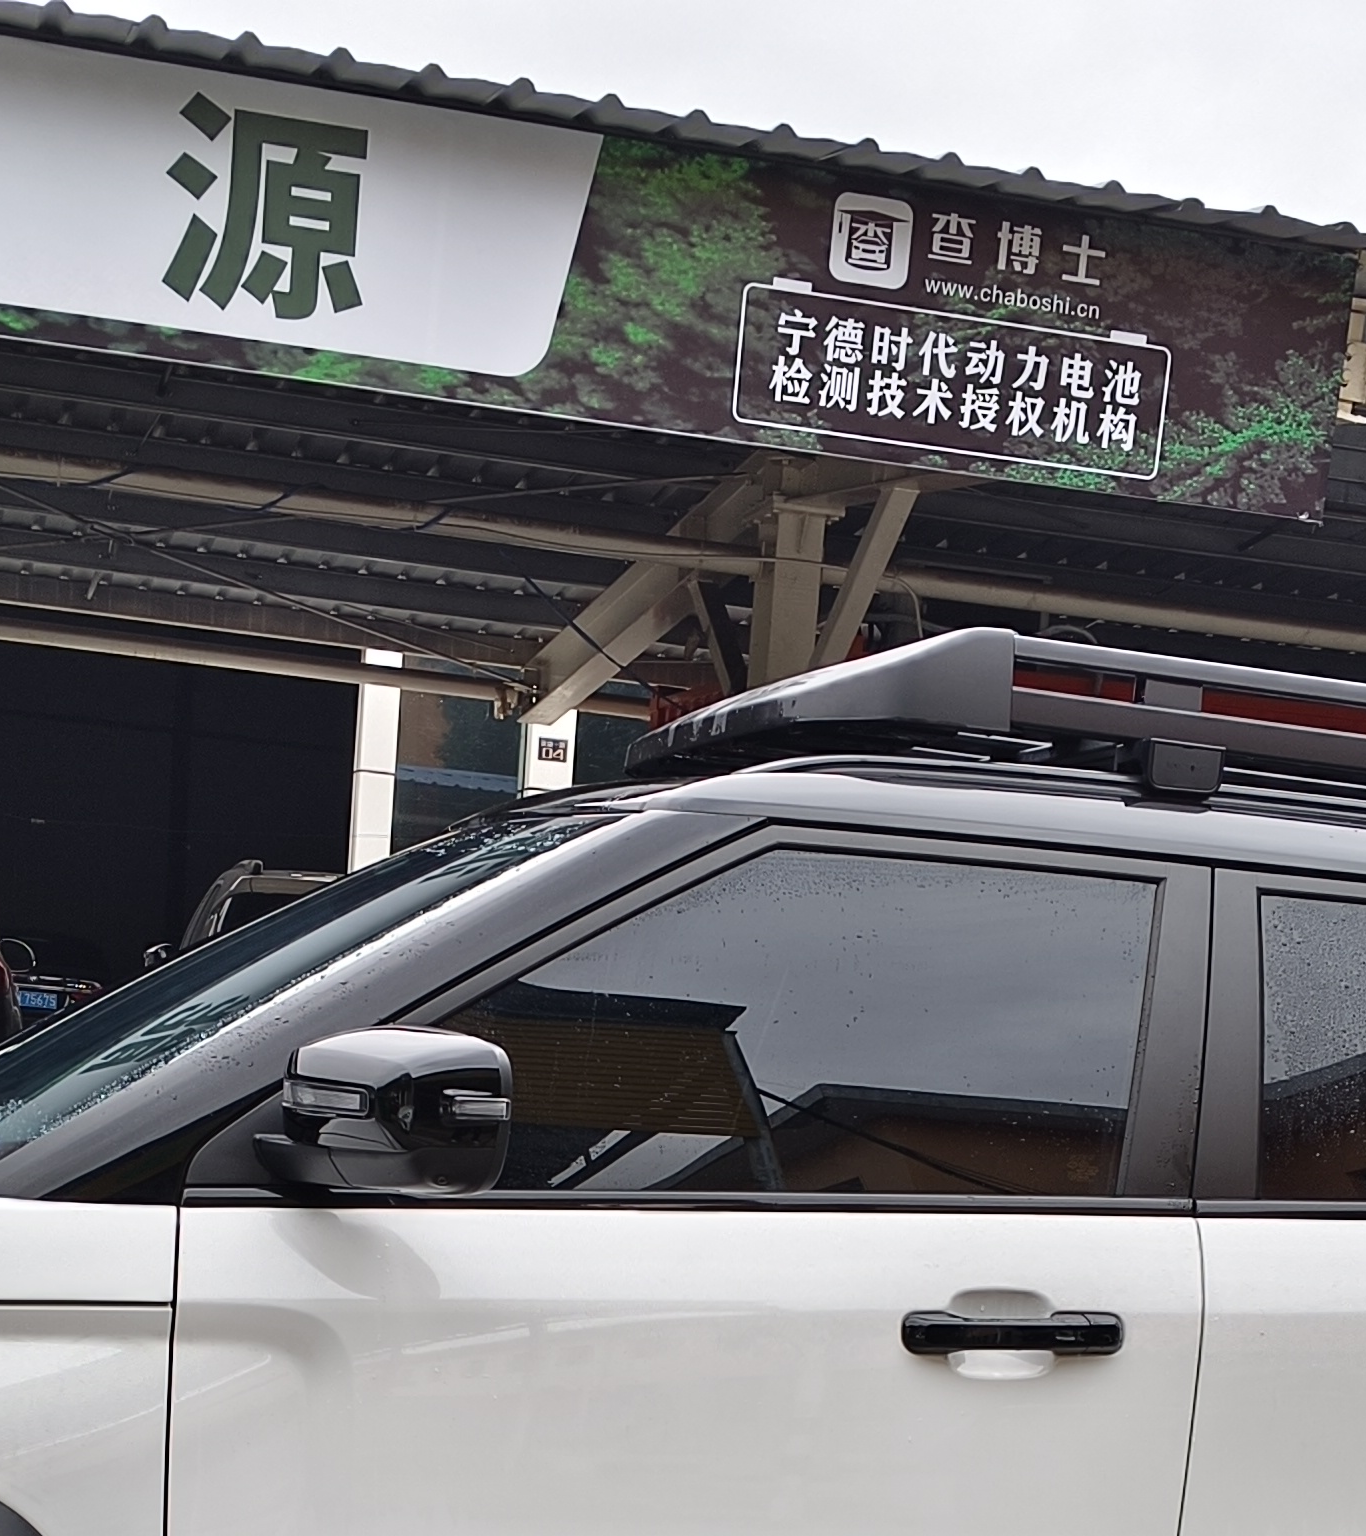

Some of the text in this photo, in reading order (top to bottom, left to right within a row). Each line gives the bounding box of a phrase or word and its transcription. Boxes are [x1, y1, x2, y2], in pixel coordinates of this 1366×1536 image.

[928, 212, 1106, 286] 查博士
[924, 279, 1100, 320] www.chaboshi.cn
[777, 309, 1142, 406] 宁德时代动力电池
[769, 356, 1138, 452] 检测技术授权机构
[542, 747, 564, 760] 04
